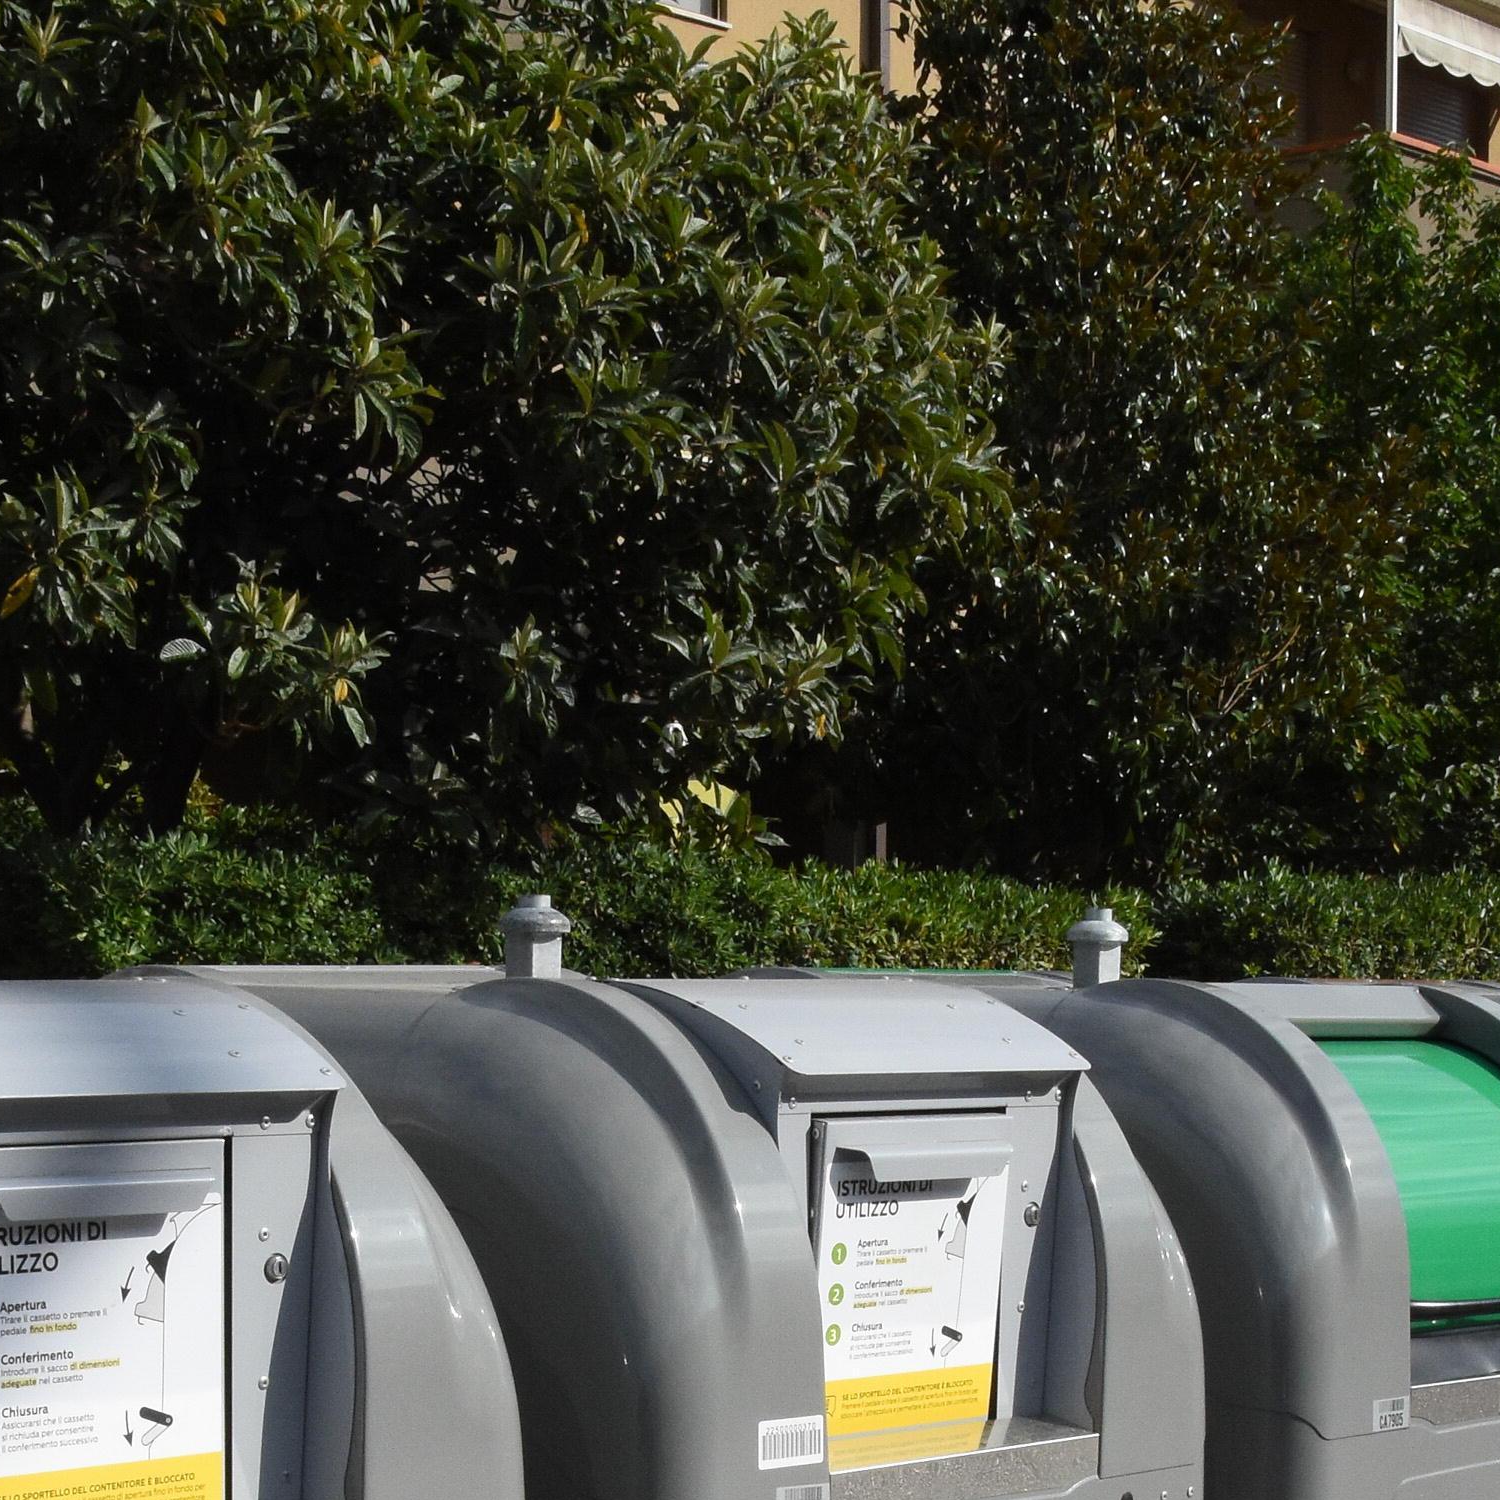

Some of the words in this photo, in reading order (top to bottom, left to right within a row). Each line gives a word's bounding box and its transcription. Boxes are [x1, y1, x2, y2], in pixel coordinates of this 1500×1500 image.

[836, 1199, 898, 1219] UTILIZZO
[87, 1221, 106, 1239] DI
[857, 1239, 887, 1249] Apertura
[836, 1248, 841, 1259] 1
[854, 1278, 902, 1289] Conferimento
[833, 1289, 839, 1301] 2
[0, 1301, 45, 1313] Apertura
[0, 1316, 21, 1324] Tirare
[29, 1312, 60, 1321] cassetto
[70, 1310, 100, 1319] premere
[0, 1327, 26, 1337] pedale
[852, 1323, 882, 1331] Chiusura
[1, 1349, 72, 1364] Conferimento
[1, 1368, 38, 1376] Introdurre
[79, 1358, 119, 1368] dimensioni
[1, 1379, 36, 1388] adeguate
[52, 1374, 82, 1382] cassetto
[1, 1406, 48, 1417] Chiusura
[1, 1419, 40, 1429] Assicurarsi
[64, 1413, 93, 1422] cassetto
[9, 1431, 39, 1440] richiuda
[55, 1426, 93, 1435] consentire
[7, 1440, 57, 1451] conferimento
[59, 1436, 97, 1445] successivo
[22, 1488, 69, 1500] SPORTELLO
[72, 1486, 87, 1494] DEL
[89, 1478, 145, 1492] CONTENITORE
[154, 1472, 194, 1484] BLOCCATO
